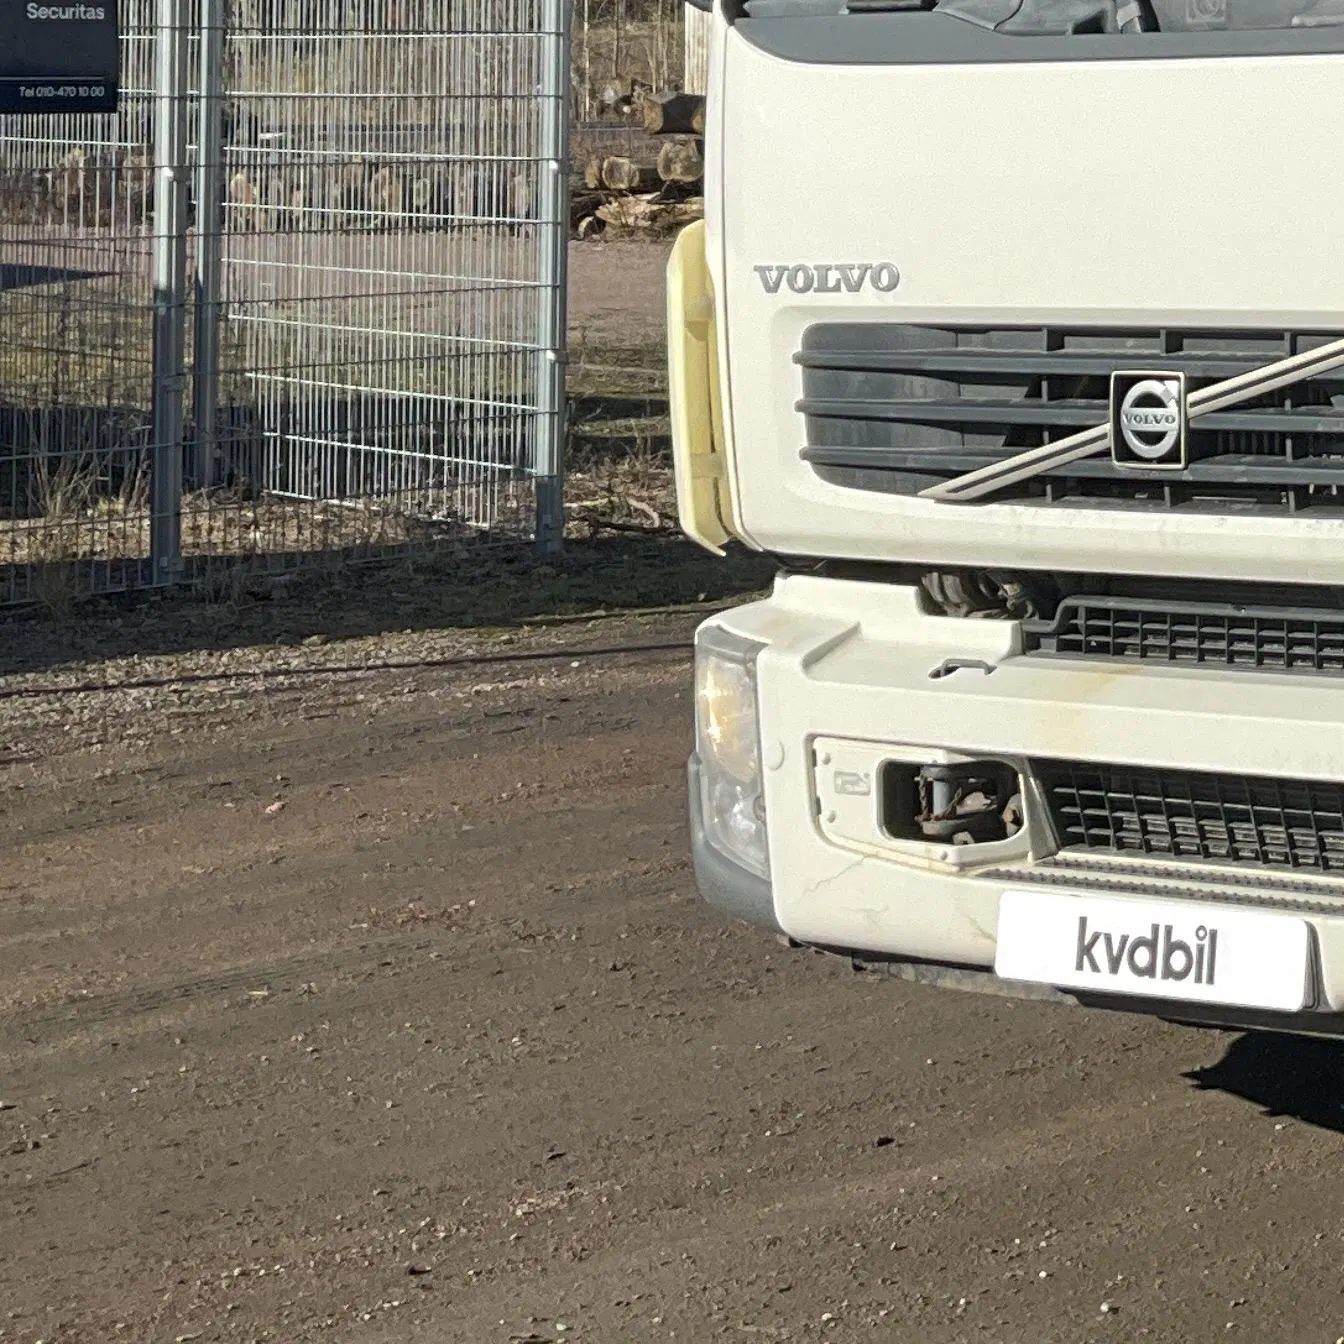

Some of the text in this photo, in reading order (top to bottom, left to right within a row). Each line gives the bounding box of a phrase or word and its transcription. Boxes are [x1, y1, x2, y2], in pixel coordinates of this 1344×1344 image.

[26, 2, 105, 20] Securitas
[19, 86, 105, 98] Tel 010-470 10 00
[753, 262, 900, 294] VOLVO
[1123, 414, 1176, 425] VOLVO
[1075, 916, 1218, 985] kvdbil
